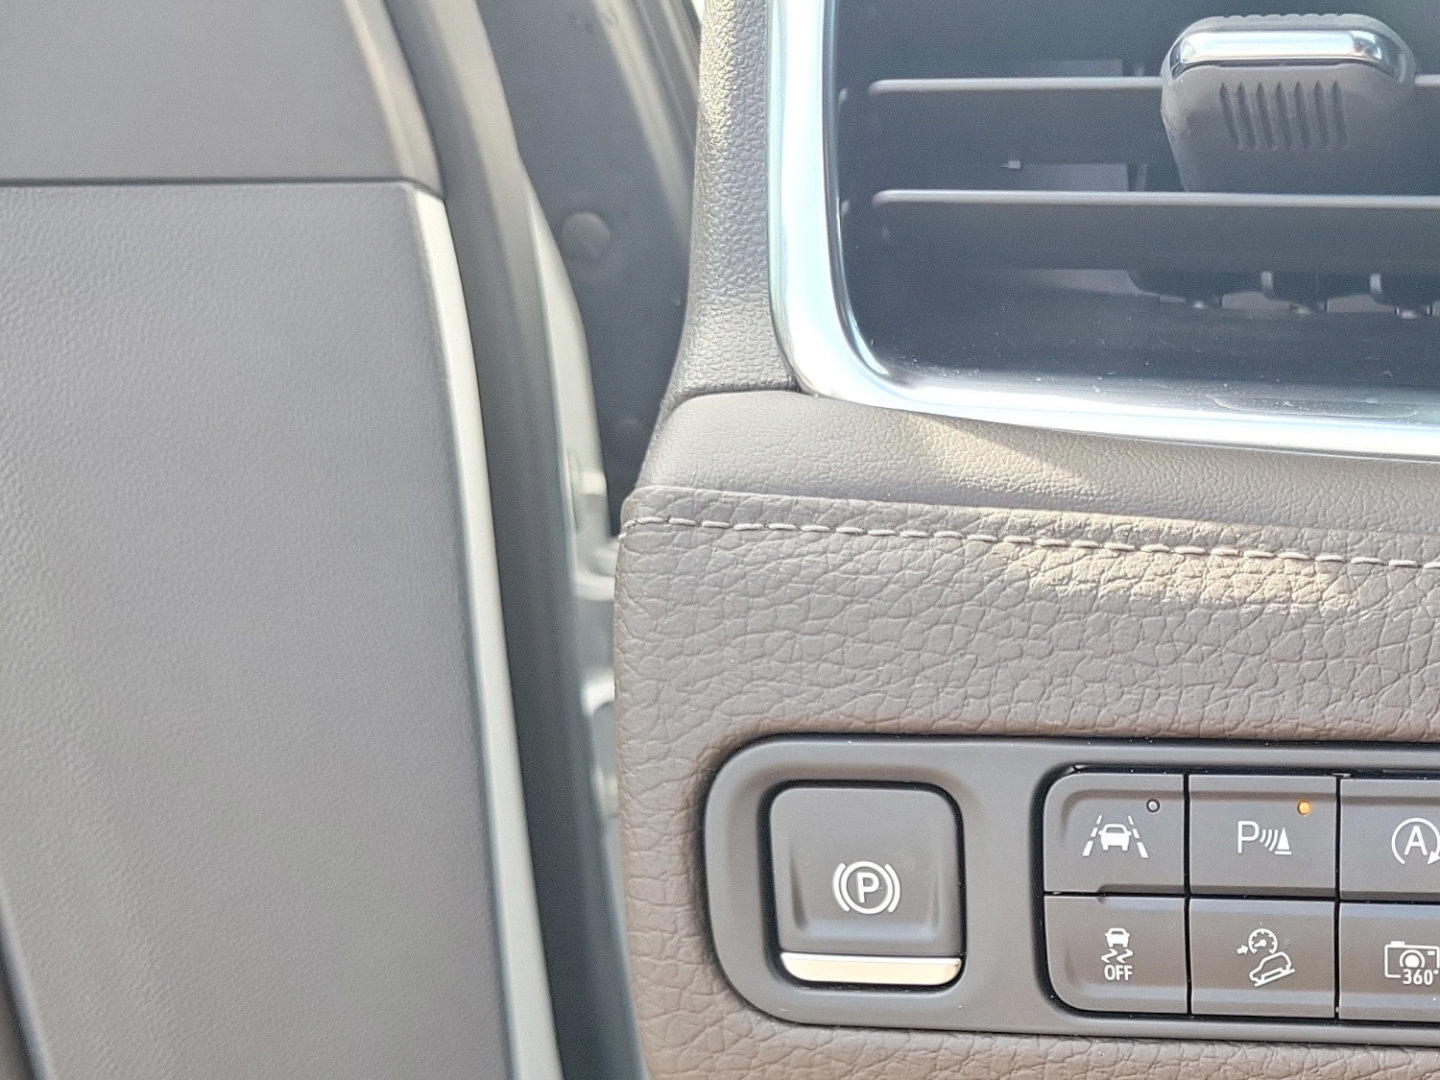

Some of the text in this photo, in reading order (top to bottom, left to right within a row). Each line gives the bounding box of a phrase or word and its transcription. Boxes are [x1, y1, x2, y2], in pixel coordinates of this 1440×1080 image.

[1237, 820, 1256, 854] P
[1405, 818, 1428, 847] A
[855, 873, 881, 905] P
[1102, 964, 1133, 981] OFF
